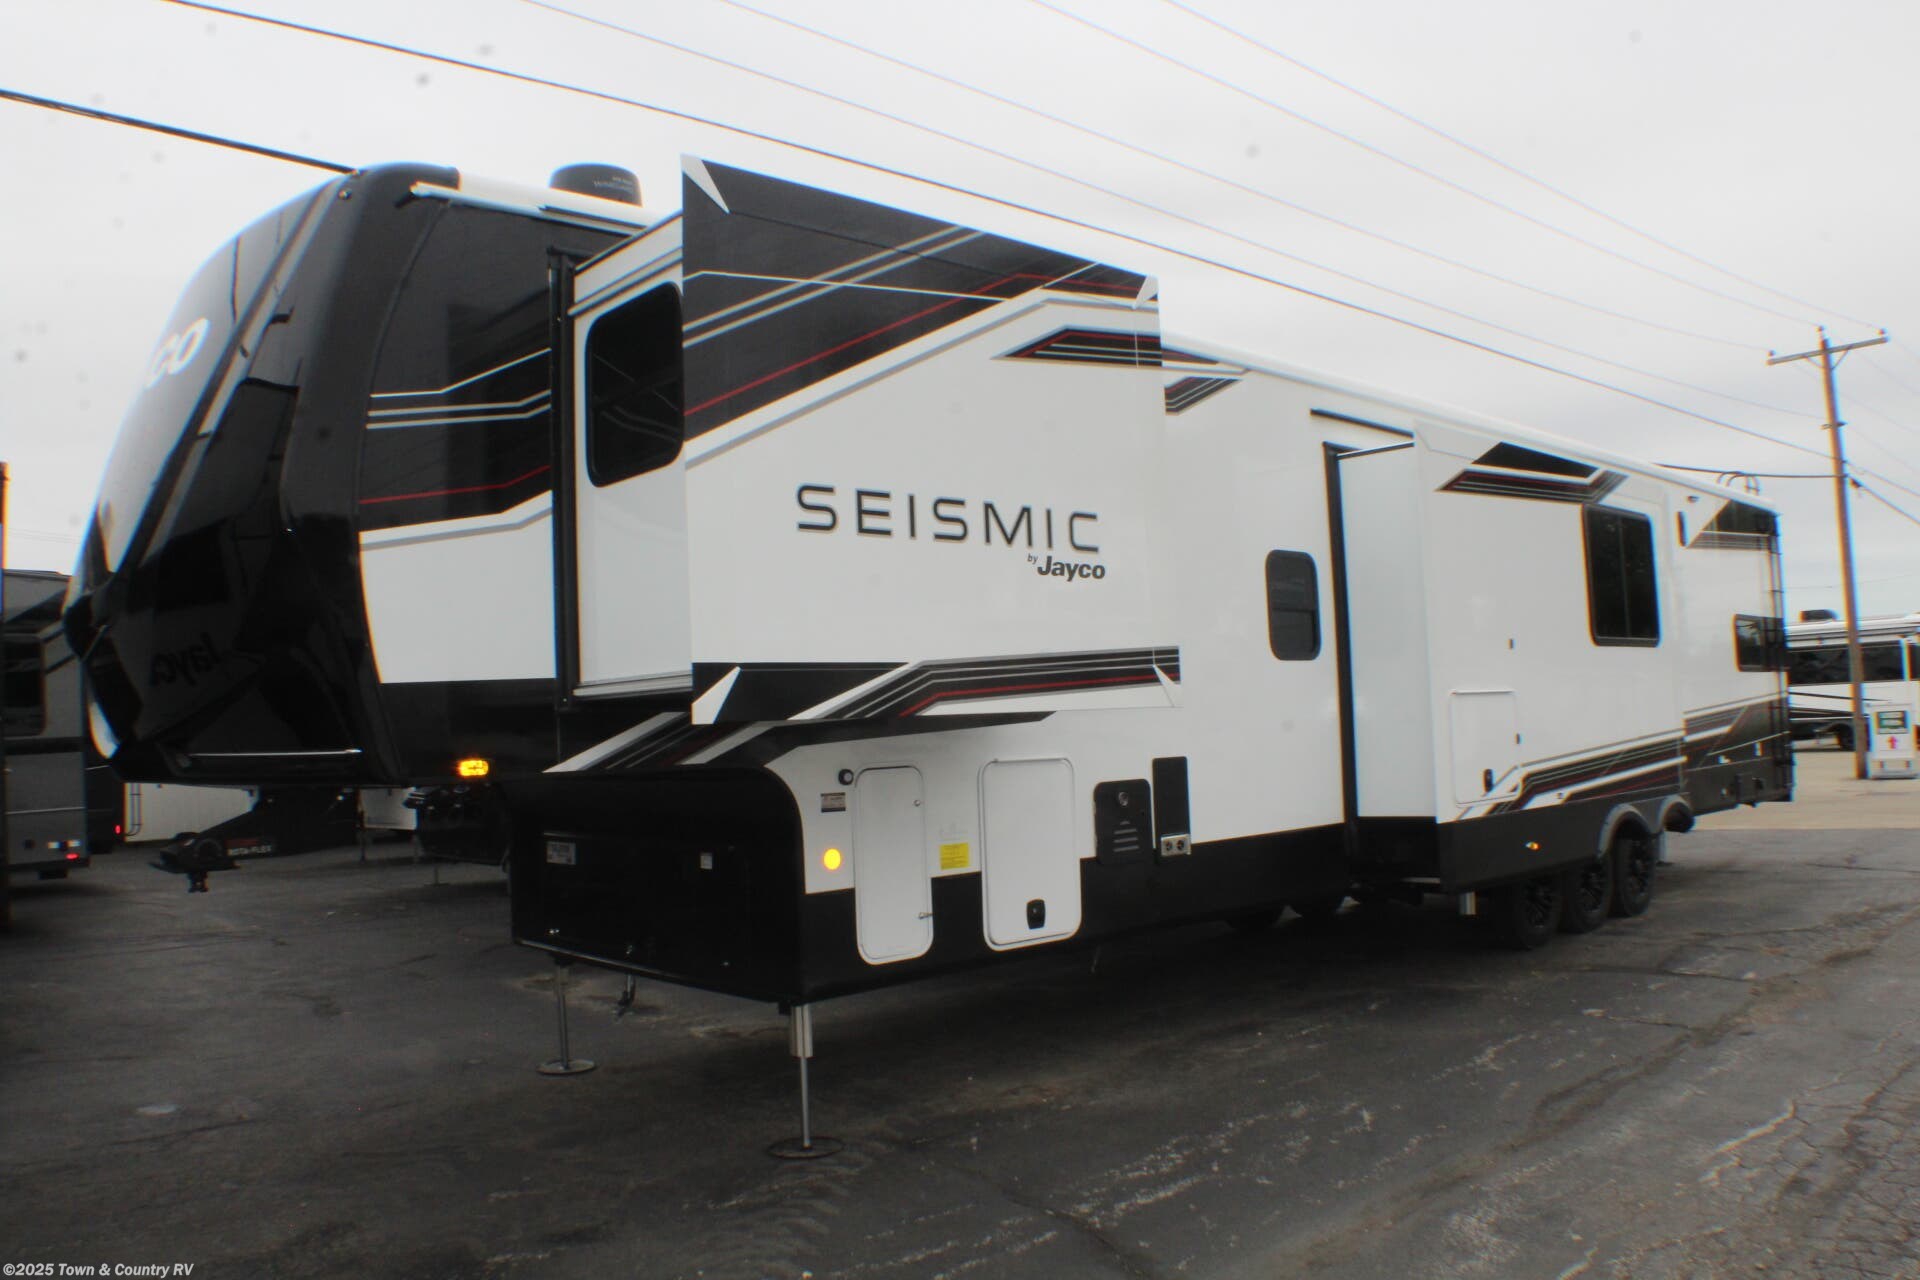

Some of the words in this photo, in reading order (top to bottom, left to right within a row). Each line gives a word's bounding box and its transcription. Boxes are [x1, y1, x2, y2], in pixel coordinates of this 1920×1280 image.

[797, 482, 1100, 554] SEISMIC
[1027, 553, 1039, 565] by
[1037, 555, 1106, 582] Jayco
